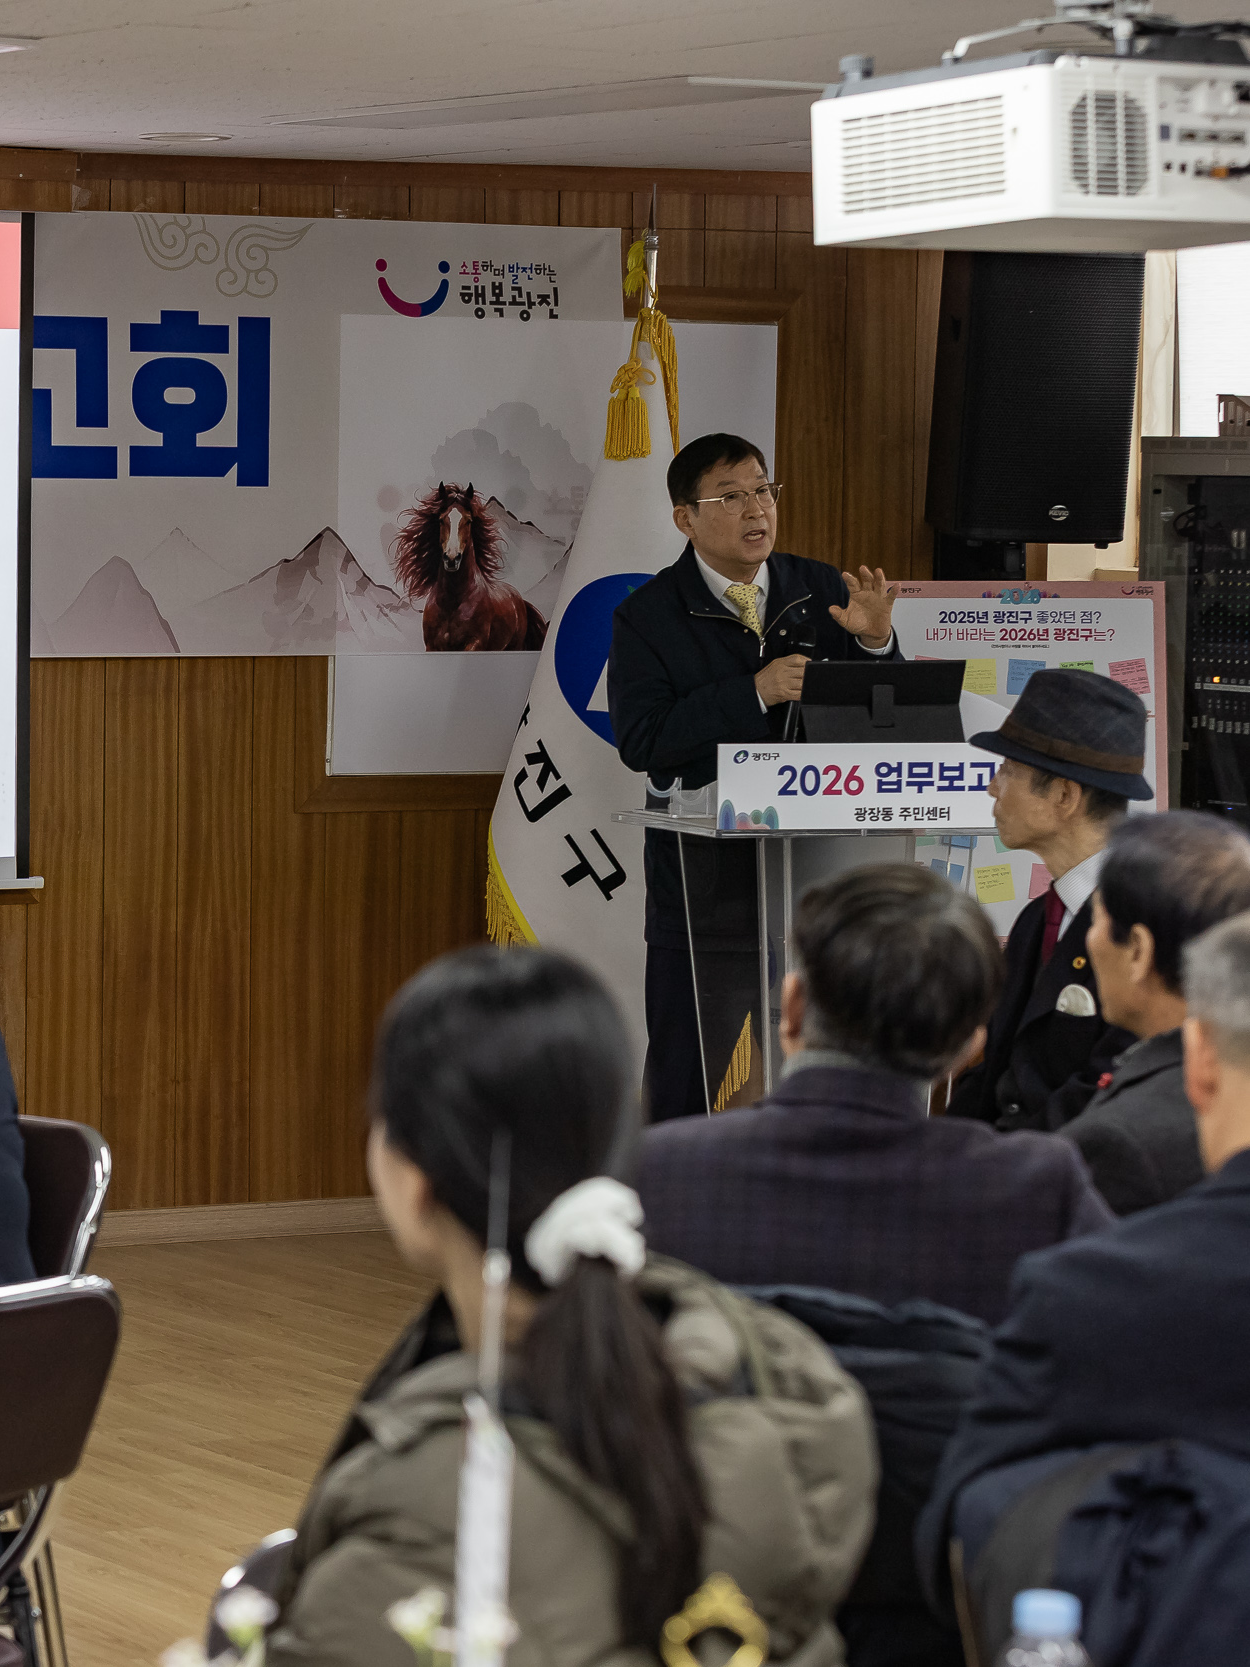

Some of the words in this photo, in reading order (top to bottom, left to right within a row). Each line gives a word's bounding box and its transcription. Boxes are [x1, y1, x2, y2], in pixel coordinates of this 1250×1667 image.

[459, 260, 505, 284] 소통하며
[508, 262, 557, 285] 발전하는
[459, 281, 559, 322] 행복광진
[938, 610, 989, 625] 2025년
[992, 610, 1032, 625] 광진구
[1036, 610, 1076, 625] 좋았던
[1080, 610, 1102, 625] 점?
[926, 627, 953, 642] 내가
[956, 627, 996, 642] 바라는
[999, 627, 1049, 642] 2026년
[1053, 627, 1115, 642] 광진구는?
[751, 752, 780, 761] 광진구
[777, 764, 865, 797] 2026
[874, 761, 997, 794] 업무보고
[513, 702, 628, 902] 진구
[854, 806, 894, 822] 광장동
[898, 806, 951, 822] 주민센터
